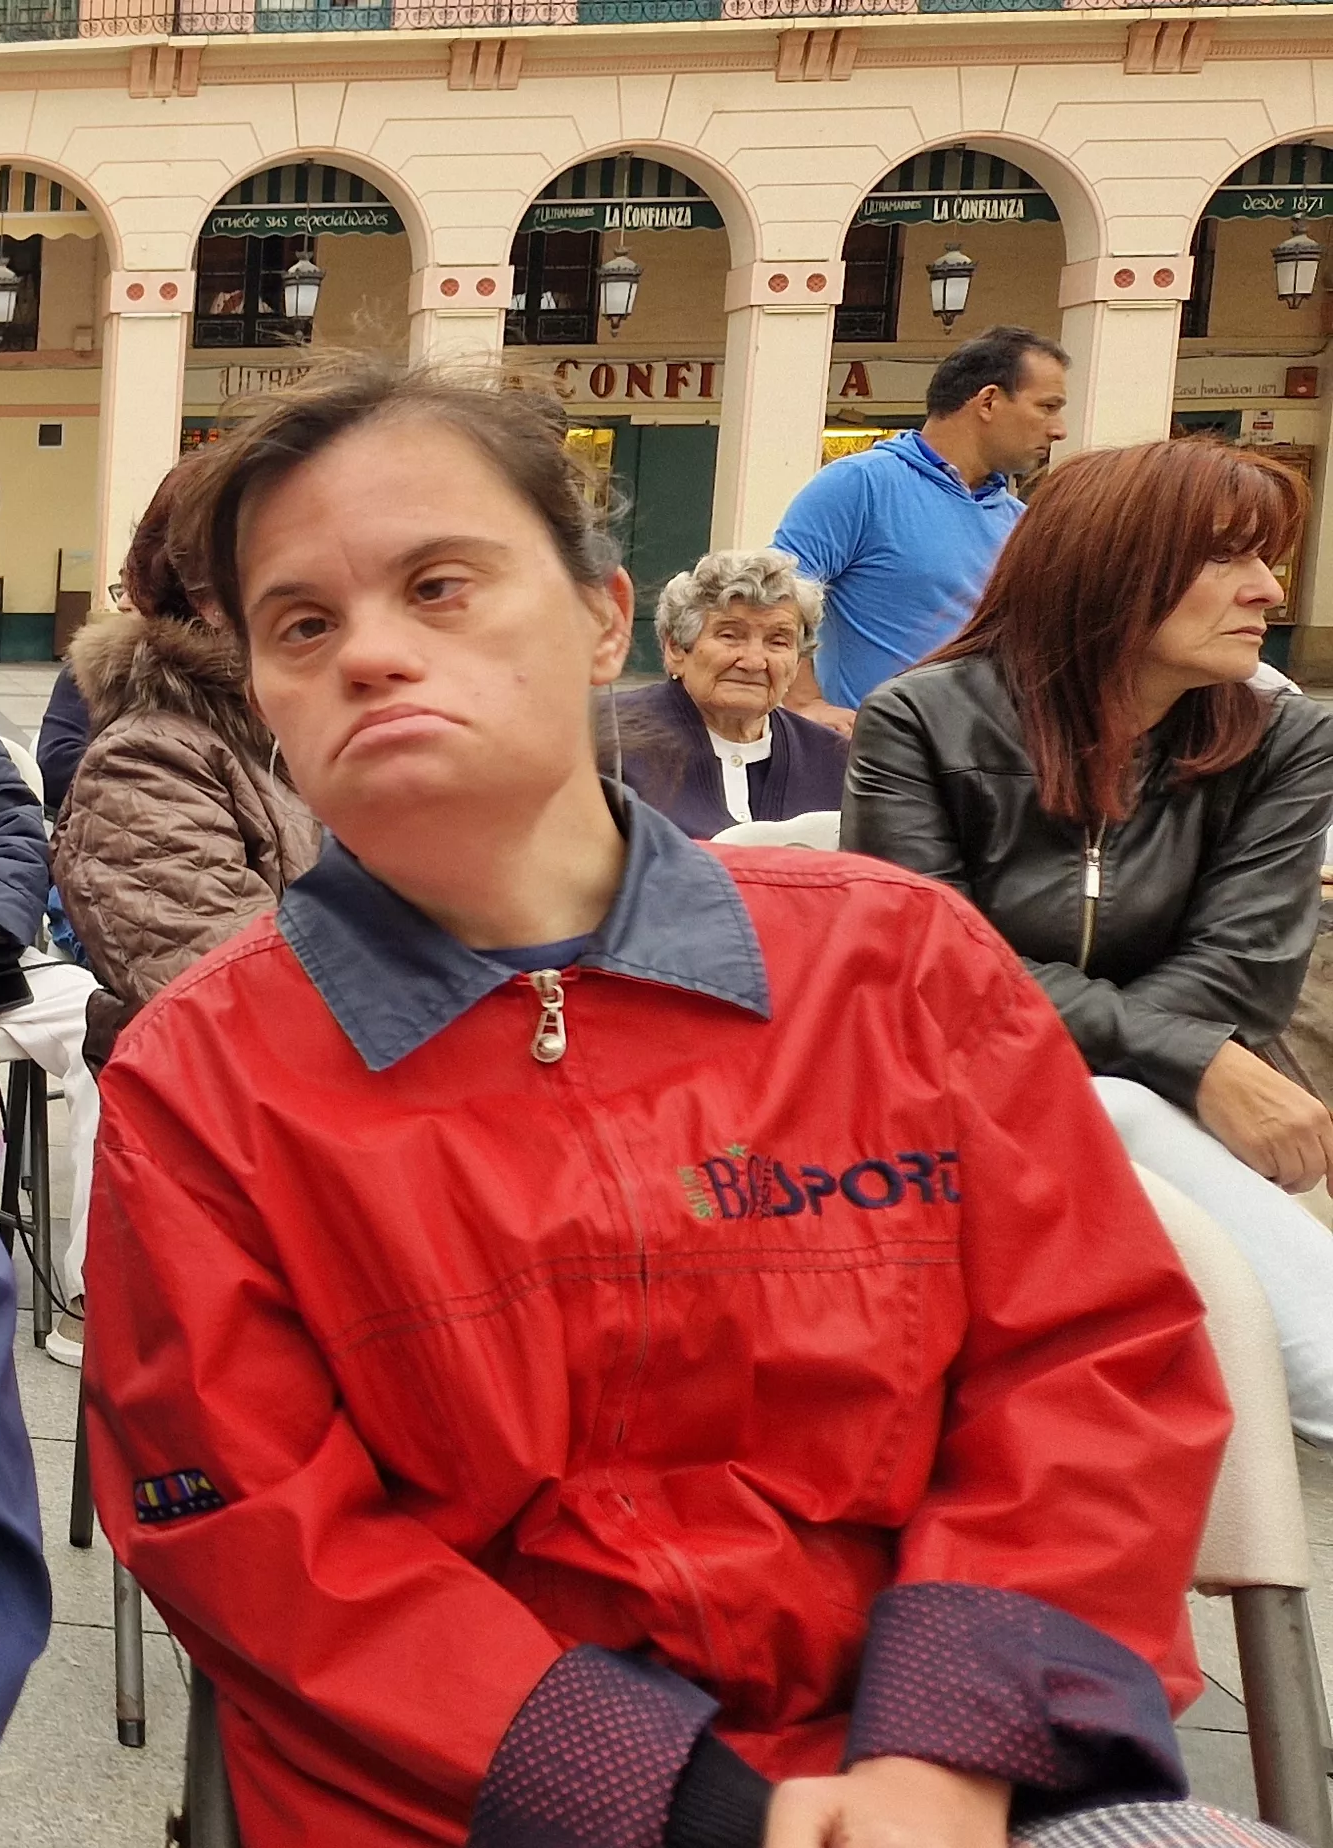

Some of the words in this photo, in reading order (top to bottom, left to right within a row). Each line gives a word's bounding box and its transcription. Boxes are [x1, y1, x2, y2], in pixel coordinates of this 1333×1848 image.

[933, 197, 949, 221] LA
[953, 197, 1025, 220] CONFIANZA
[1242, 193, 1285, 211] desde
[1291, 195, 1324, 213] 1871
[212, 212, 260, 233] pruebe
[265, 214, 288, 228] sus
[294, 209, 389, 233] especialidades
[604, 204, 620, 228] LA
[624, 204, 692, 228] CONFIANZA
